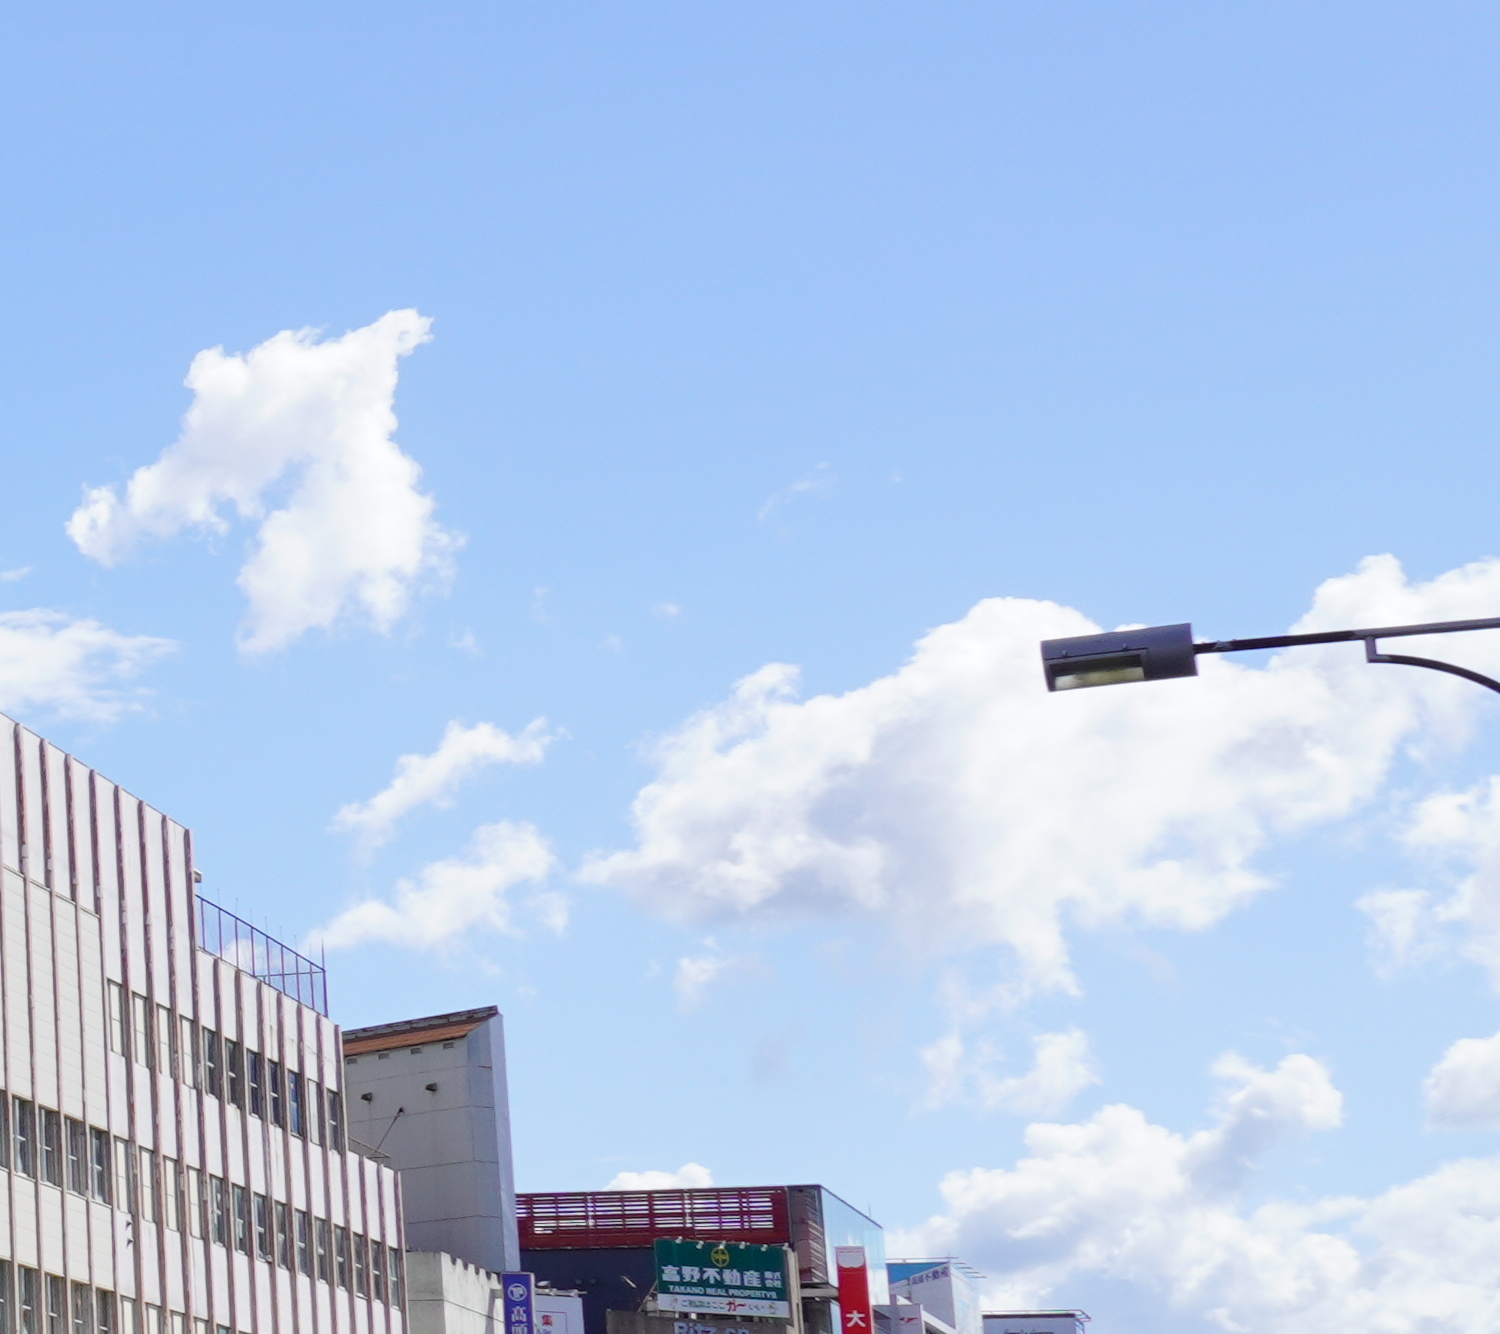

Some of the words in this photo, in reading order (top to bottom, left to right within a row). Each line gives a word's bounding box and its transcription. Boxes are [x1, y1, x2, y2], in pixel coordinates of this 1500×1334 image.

[661, 1264, 762, 1287] 高野不動産
[668, 1284, 704, 1295] TAKANO
[706, 1286, 726, 1296] REAL
